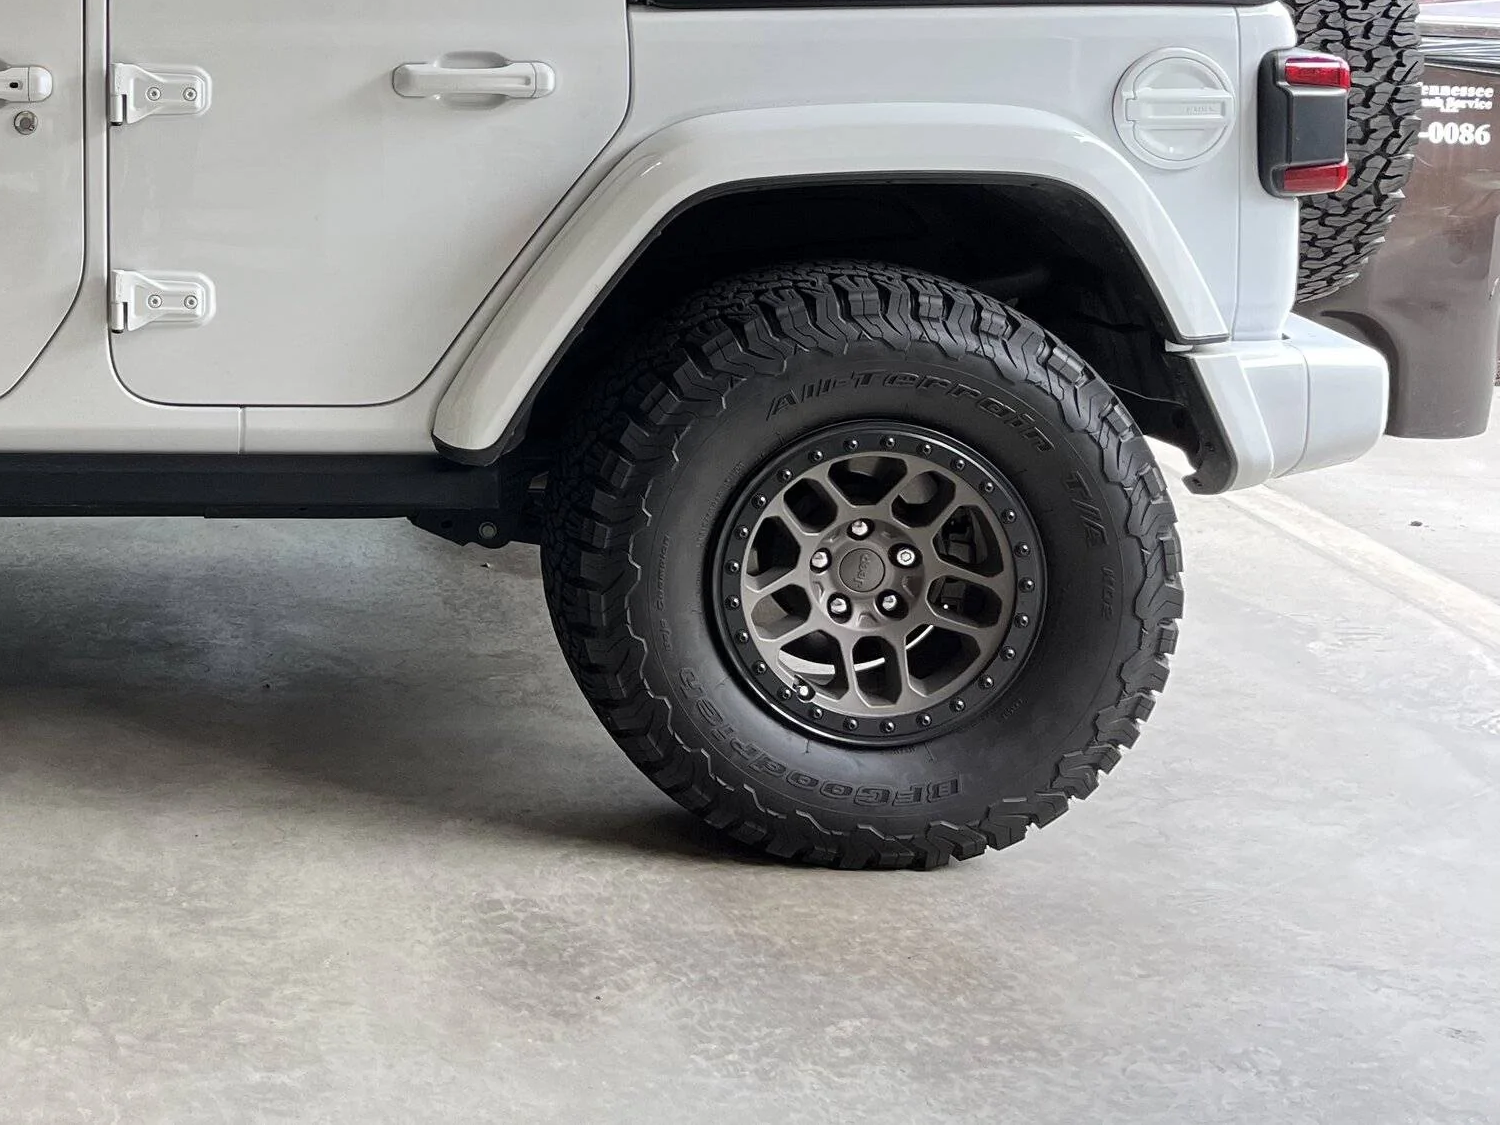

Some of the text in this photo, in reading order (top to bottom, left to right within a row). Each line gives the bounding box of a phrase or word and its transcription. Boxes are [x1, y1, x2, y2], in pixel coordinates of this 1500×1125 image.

[1417, 82, 1494, 98] ennessee
[1446, 97, 1493, 110] Service
[766, 370, 1056, 452] All-Terrain
